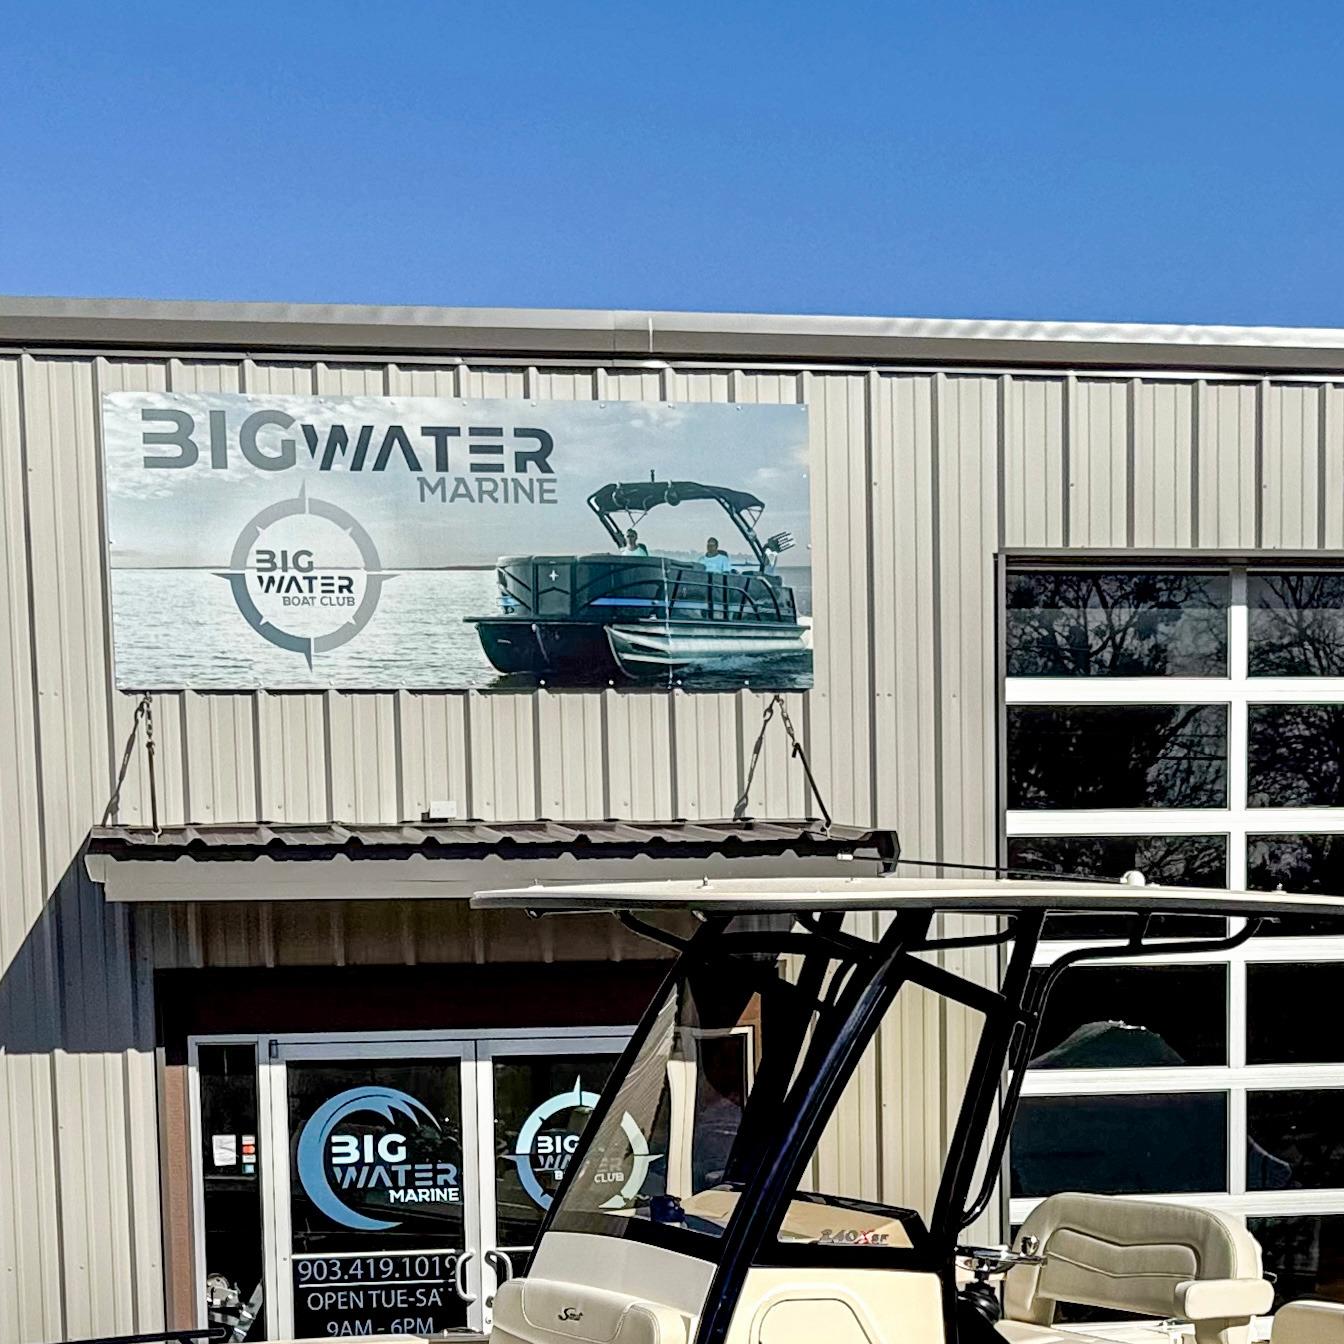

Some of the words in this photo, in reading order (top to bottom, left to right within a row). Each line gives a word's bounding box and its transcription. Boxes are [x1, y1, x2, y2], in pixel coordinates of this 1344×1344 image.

[417, 476, 558, 504] MARINE
[255, 549, 314, 573] BIG
[257, 575, 354, 595] WATER
[282, 596, 317, 607] BOAT
[320, 595, 356, 607] CLUB
[331, 1133, 407, 1164] BIG
[537, 1135, 580, 1154] BIG
[333, 1163, 457, 1189] WATER
[594, 1172, 625, 1183] CLUB
[388, 1187, 460, 1203] MARINE
[307, 1291, 364, 1311] OPEN
[368, 1288, 453, 1309] TUE-SA
[327, 1319, 373, 1337] 9AM
[390, 1317, 434, 1335] 6PM
